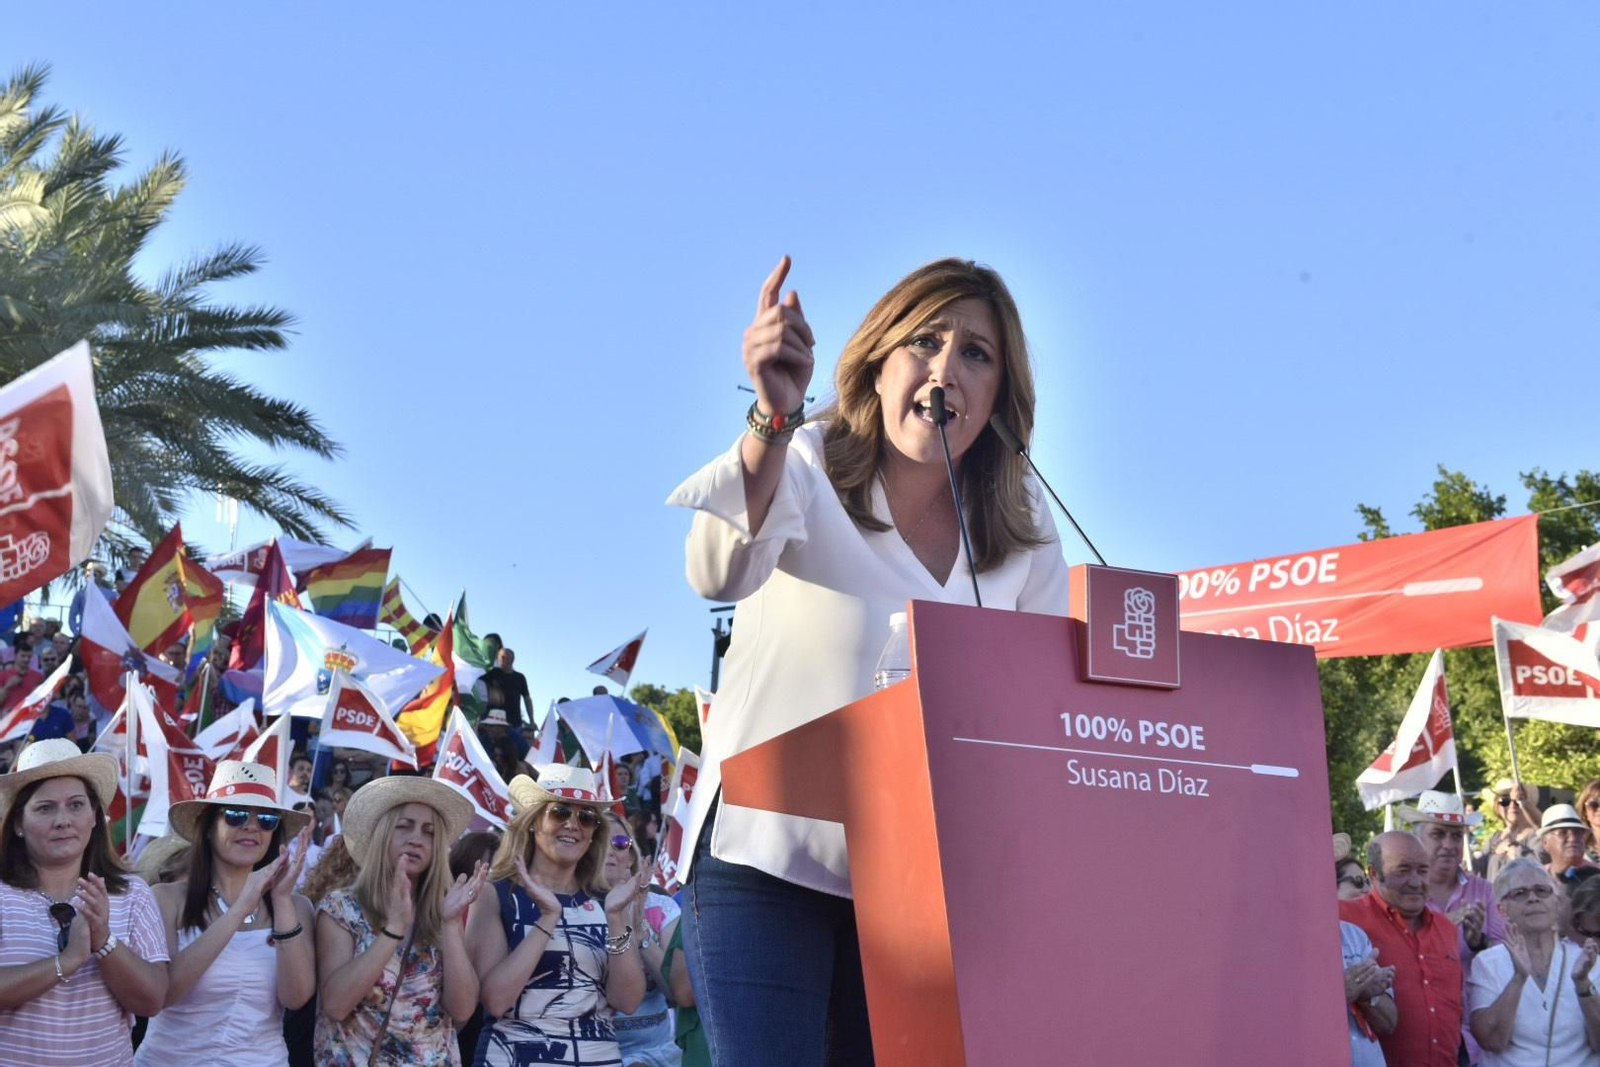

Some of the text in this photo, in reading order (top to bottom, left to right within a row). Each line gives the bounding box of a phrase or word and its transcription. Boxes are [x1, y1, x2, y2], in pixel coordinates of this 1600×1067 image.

[1178, 552, 1340, 600] 00% PSOE
[1268, 612, 1340, 644] Díaz
[1515, 664, 1583, 687] PSOE
[336, 706, 376, 728] PSOE
[1059, 711, 1207, 751] 100% PSOE
[183, 756, 208, 800] SOE
[1066, 758, 1210, 798] Susana Díaz
